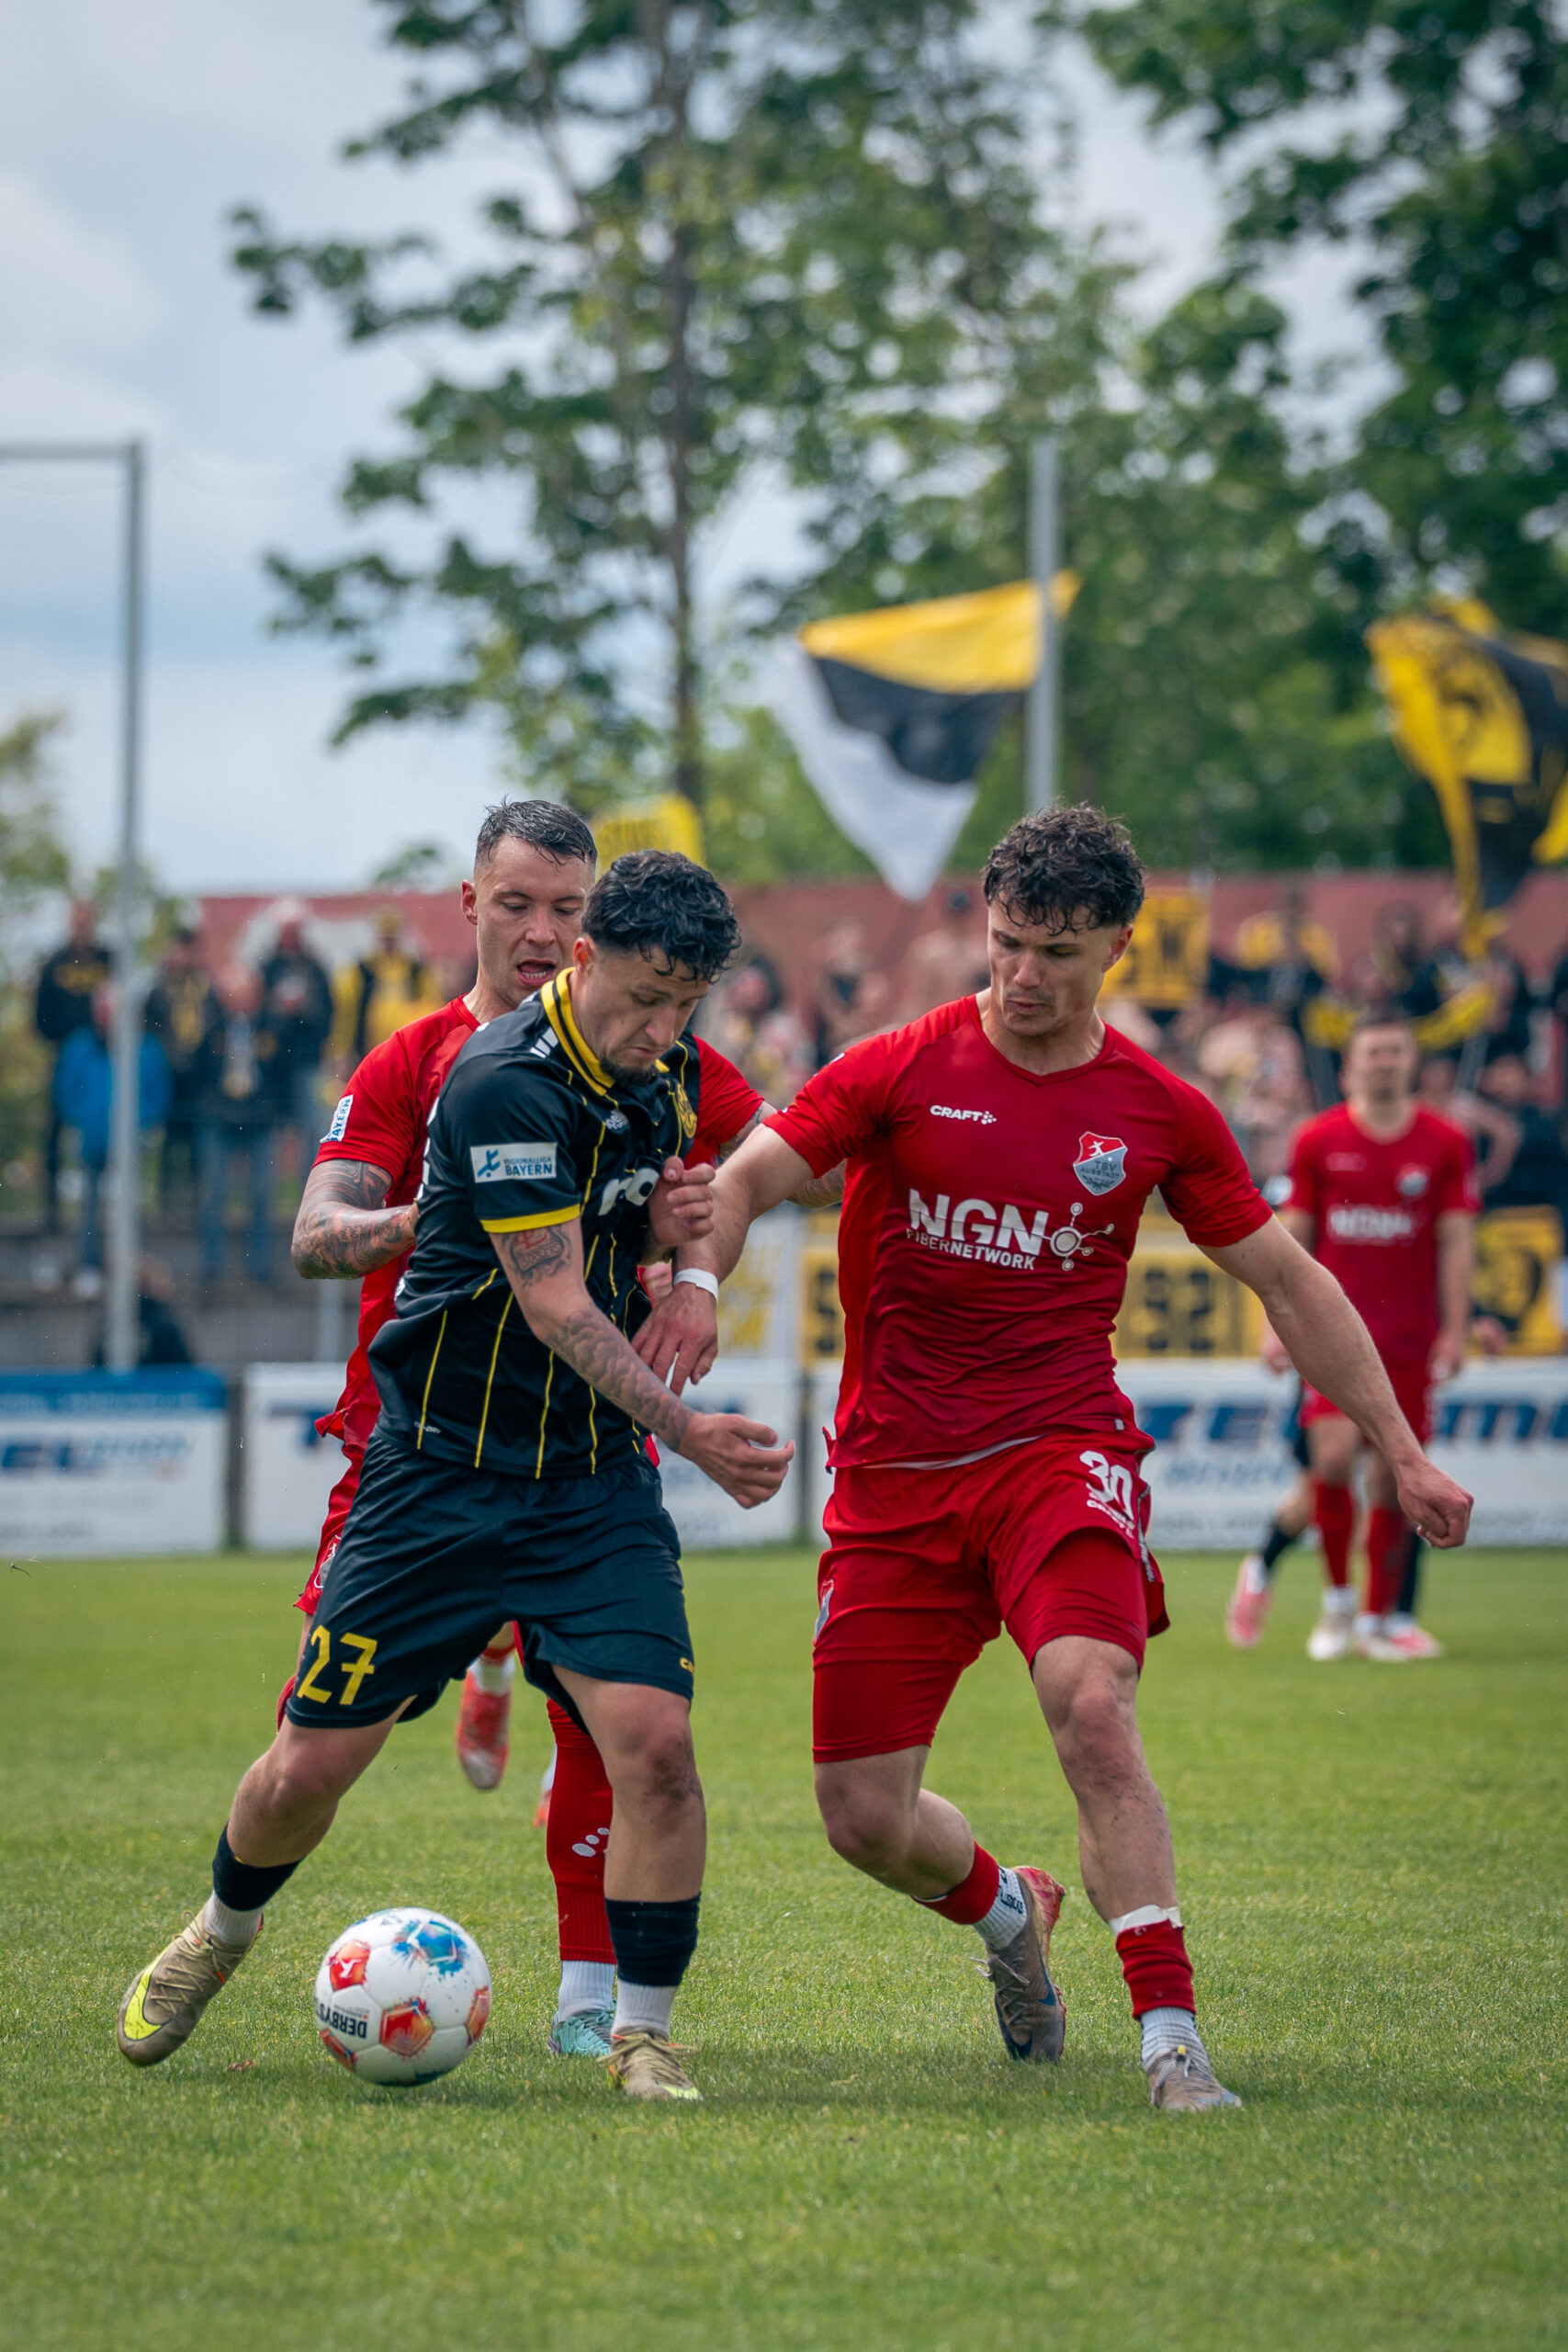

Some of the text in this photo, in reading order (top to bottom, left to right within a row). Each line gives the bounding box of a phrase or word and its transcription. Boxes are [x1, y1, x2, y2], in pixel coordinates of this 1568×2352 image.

[930, 1104, 983, 1122] CRAFT
[505, 1163, 553, 1176] BAYERN
[1094, 1160, 1117, 1171] TSV
[908, 1188, 1049, 1256] NGN
[906, 1227, 1037, 1271] FIBERNETWORK
[1079, 1450, 1134, 1521] 30
[297, 1624, 378, 1705] 27
